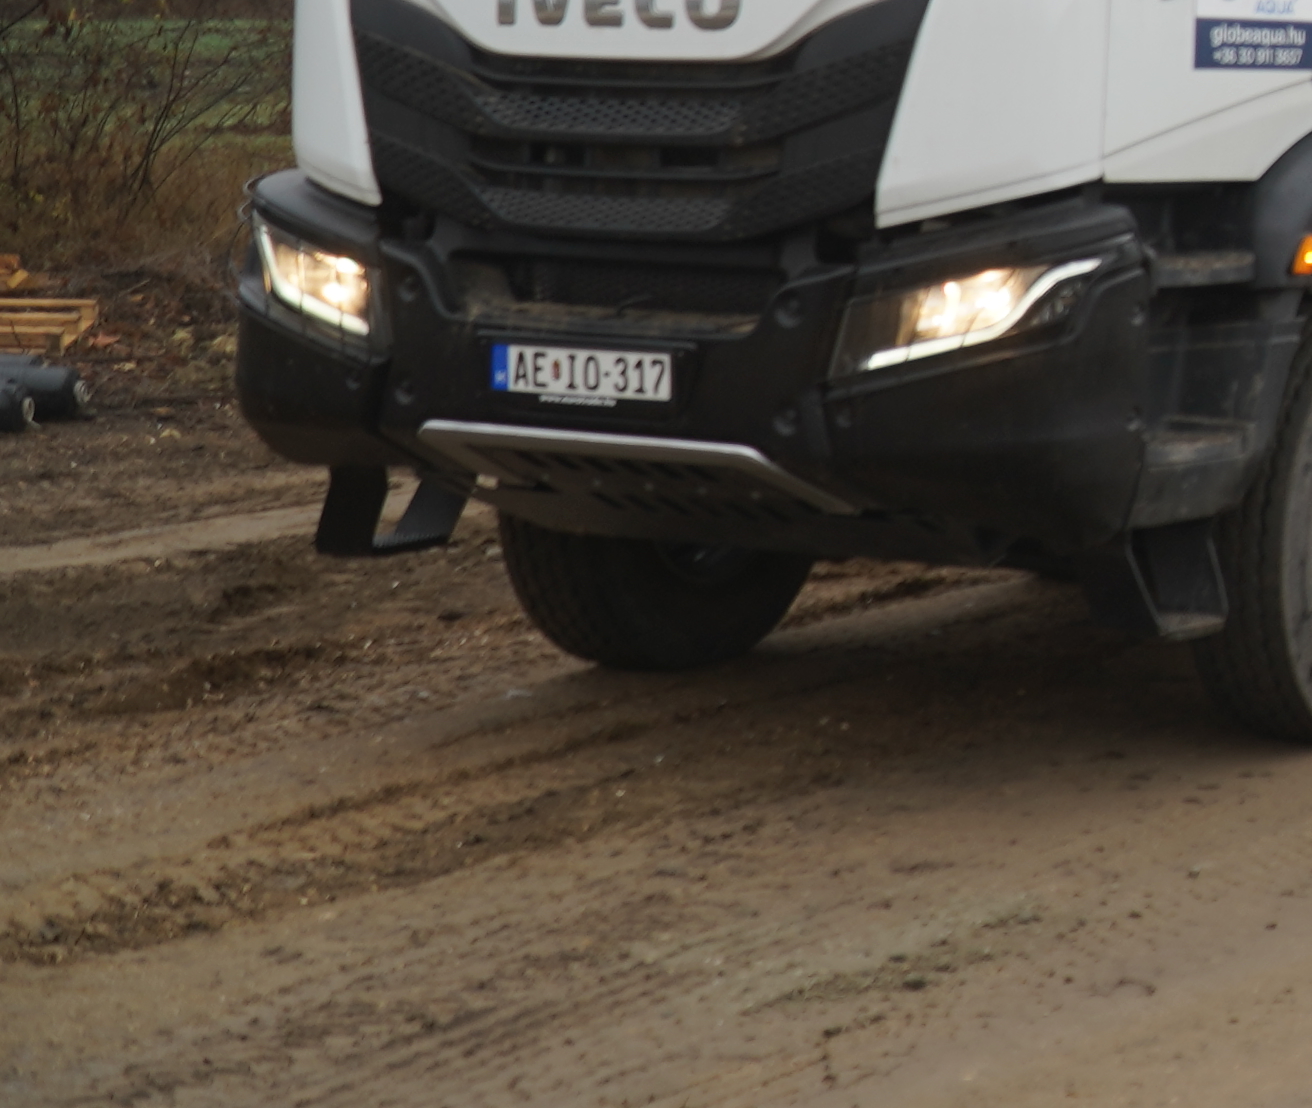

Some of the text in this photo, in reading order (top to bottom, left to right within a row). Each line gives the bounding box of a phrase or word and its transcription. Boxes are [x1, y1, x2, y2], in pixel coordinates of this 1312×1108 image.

[1255, 0, 1296, 15] AQUA
[1210, 22, 1306, 48] globeaqua.hu
[514, 351, 547, 388] AE
